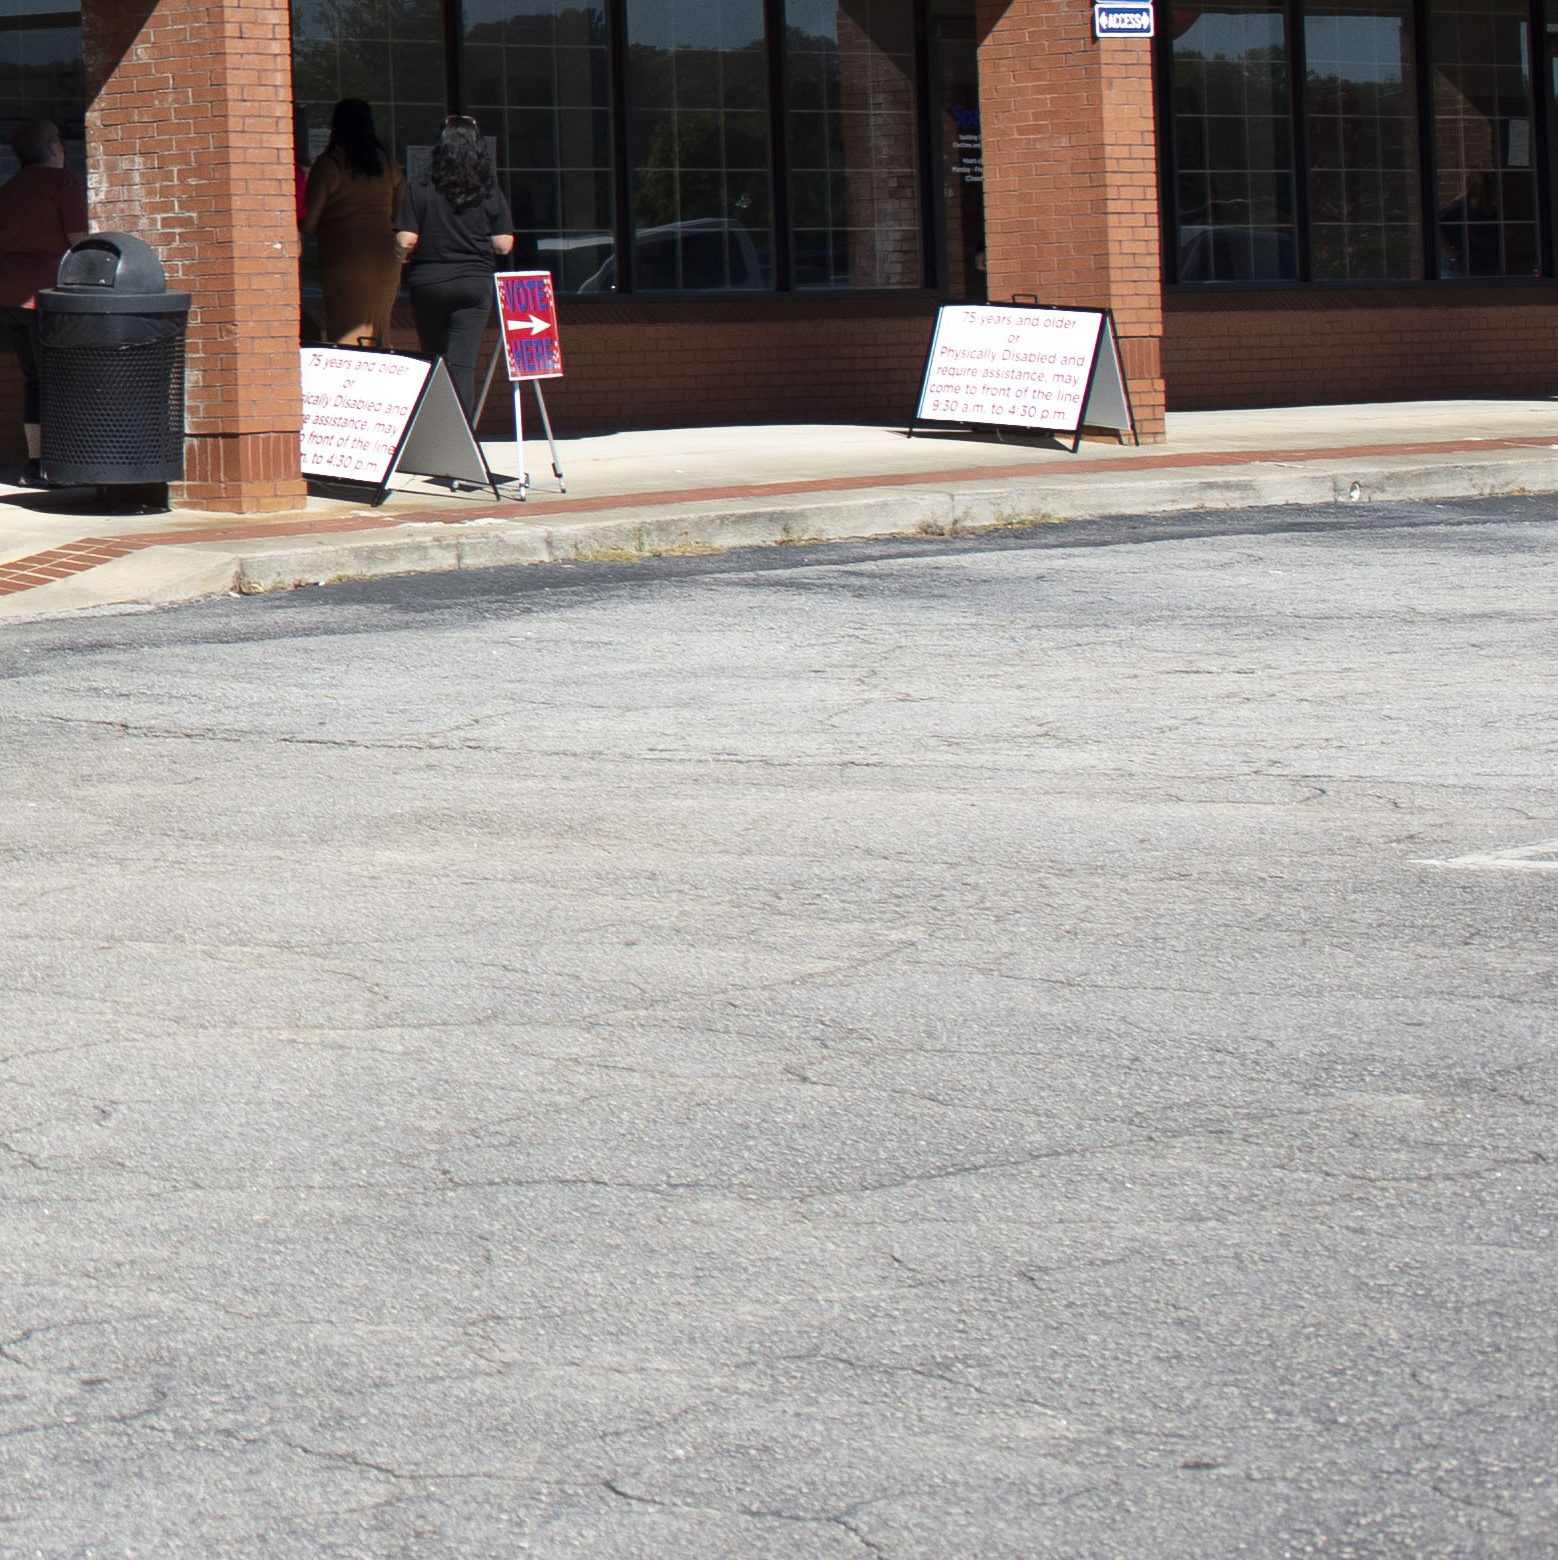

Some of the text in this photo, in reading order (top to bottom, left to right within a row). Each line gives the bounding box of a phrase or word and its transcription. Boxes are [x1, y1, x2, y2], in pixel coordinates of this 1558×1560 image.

[1107, 12, 1142, 28] ACCESS
[504, 280, 548, 313] VOTE
[963, 311, 1077, 329] 75 years and older
[1007, 334, 1021, 344] or
[309, 353, 323, 367] 75
[323, 357, 353, 370] years
[354, 360, 376, 372] and
[512, 338, 554, 372] HERE
[940, 345, 1085, 367] Physically Disabled and
[342, 378, 355, 389] or
[936, 366, 1080, 387] require assistance, may
[929, 384, 1080, 404] come to front of the line
[333, 395, 383, 412] Disabled
[384, 404, 409, 416] and
[932, 400, 1067, 421] 9:30 a.m. to 4:30 p.m.
[374, 422, 398, 438] may
[307, 430, 335, 446] front
[336, 435, 351, 448] of
[351, 437, 371, 451] the
[372, 441, 397, 456] line
[312, 452, 324, 465] to
[326, 453, 353, 468] 4:30
[353, 460, 379, 472] p.m.
